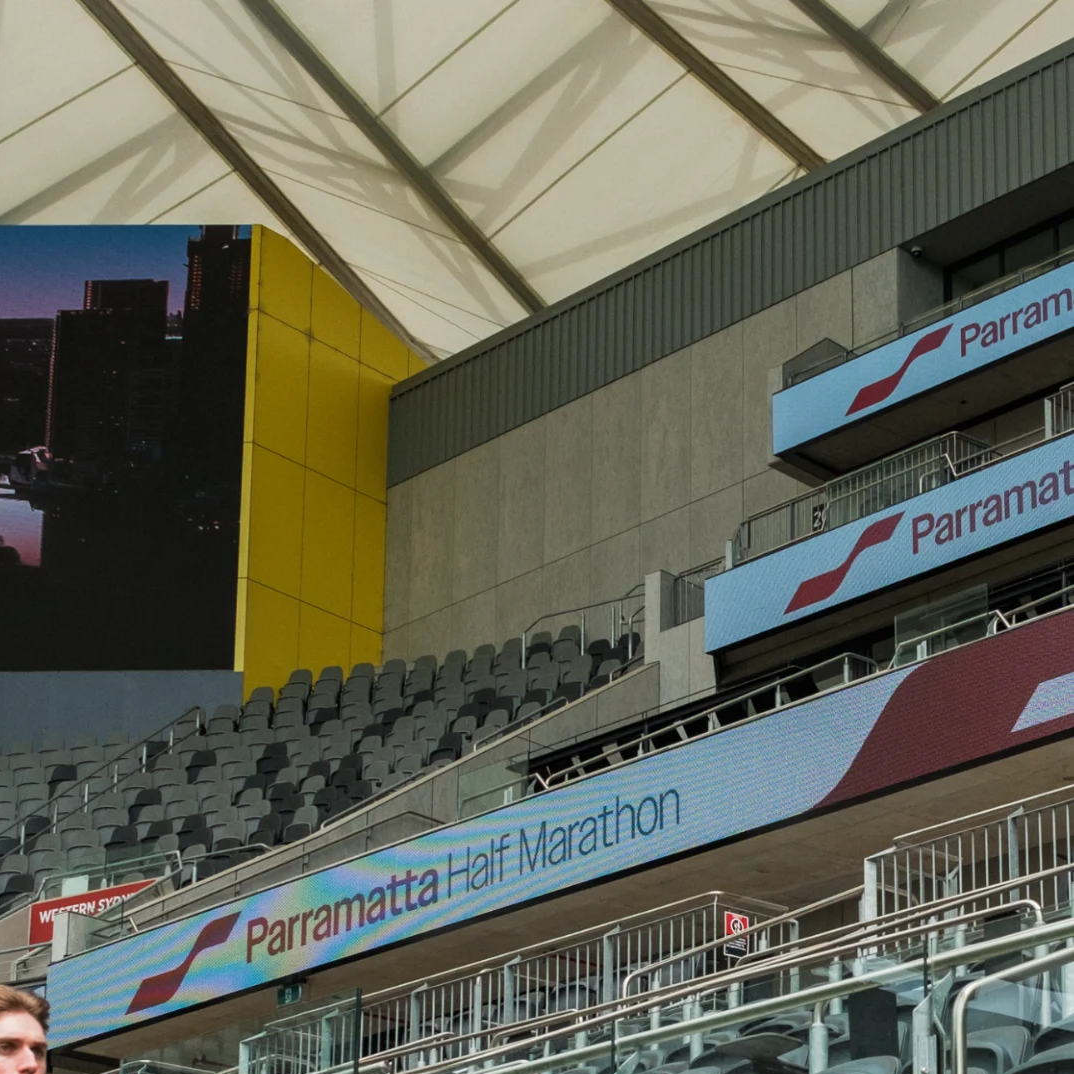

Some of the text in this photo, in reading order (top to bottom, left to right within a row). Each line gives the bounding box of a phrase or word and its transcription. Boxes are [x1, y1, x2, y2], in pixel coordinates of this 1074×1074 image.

[246, 789, 680, 964] Parramatta Half Marathon
